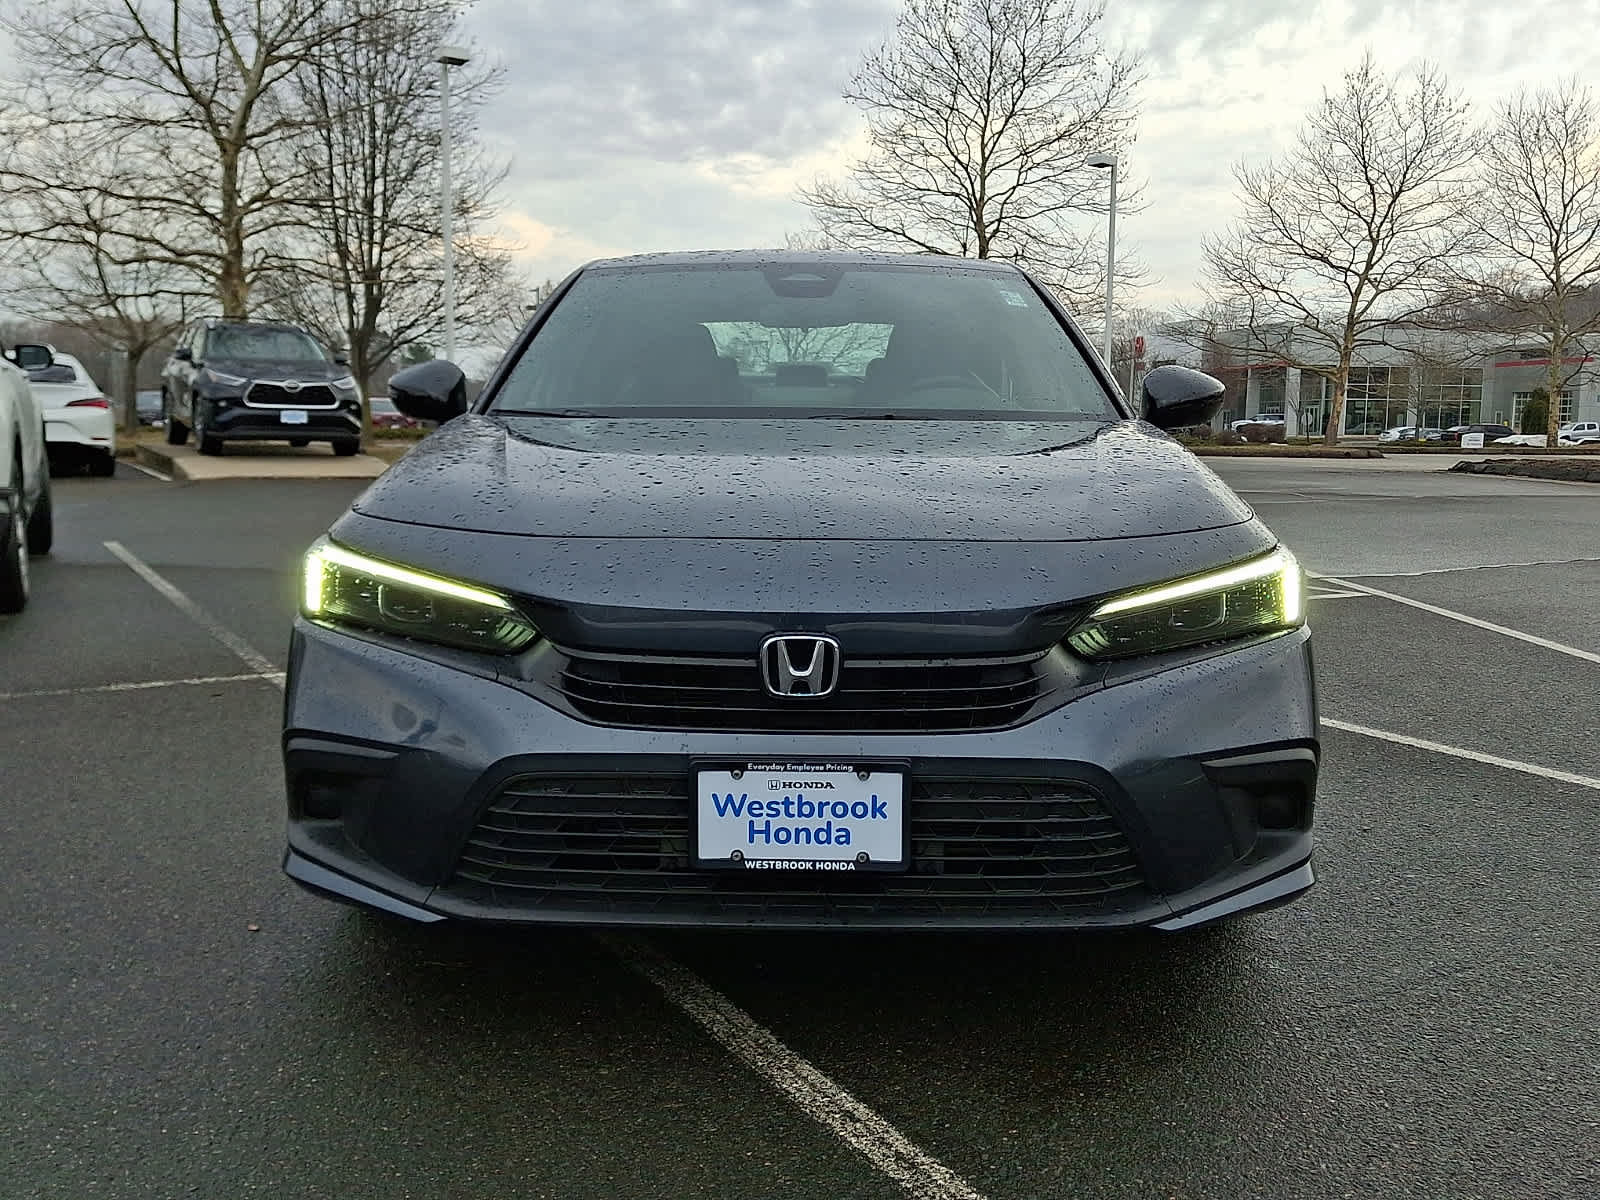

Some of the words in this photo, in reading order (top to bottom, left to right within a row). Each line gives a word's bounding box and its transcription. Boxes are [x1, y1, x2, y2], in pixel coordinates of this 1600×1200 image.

[747, 763, 785, 771] Everyday
[787, 763, 824, 772] Employee
[826, 764, 853, 772] Pricing
[711, 793, 888, 819] Westbrook
[748, 819, 851, 845] Honda
[744, 860, 813, 870] WESTBROOK
[815, 861, 856, 871] HONDA
